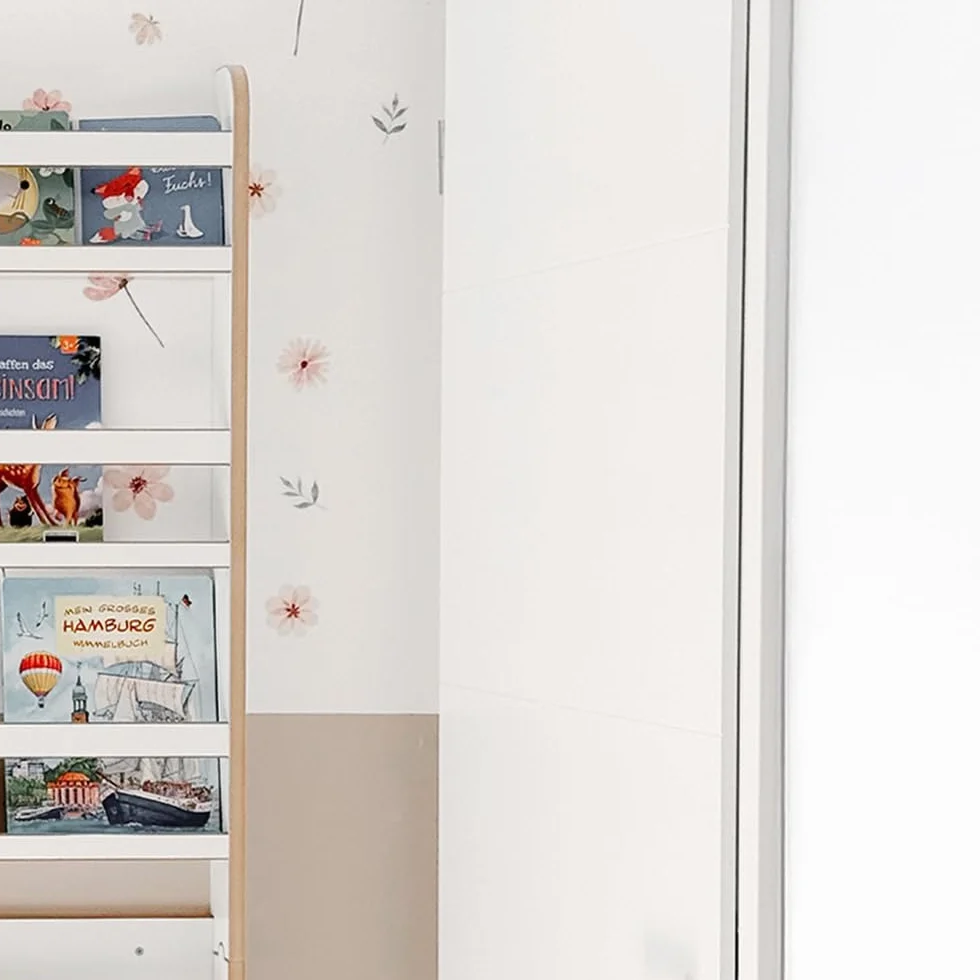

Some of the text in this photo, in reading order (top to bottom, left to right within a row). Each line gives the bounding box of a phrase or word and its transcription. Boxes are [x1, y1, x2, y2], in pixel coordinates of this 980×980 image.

[162, 171, 212, 194] Fuchs!
[32, 358, 55, 370] das
[64, 604, 156, 616] MEIN GROSSES
[63, 618, 157, 633] HAMBURG
[73, 639, 149, 649] WIMMELBUCH
